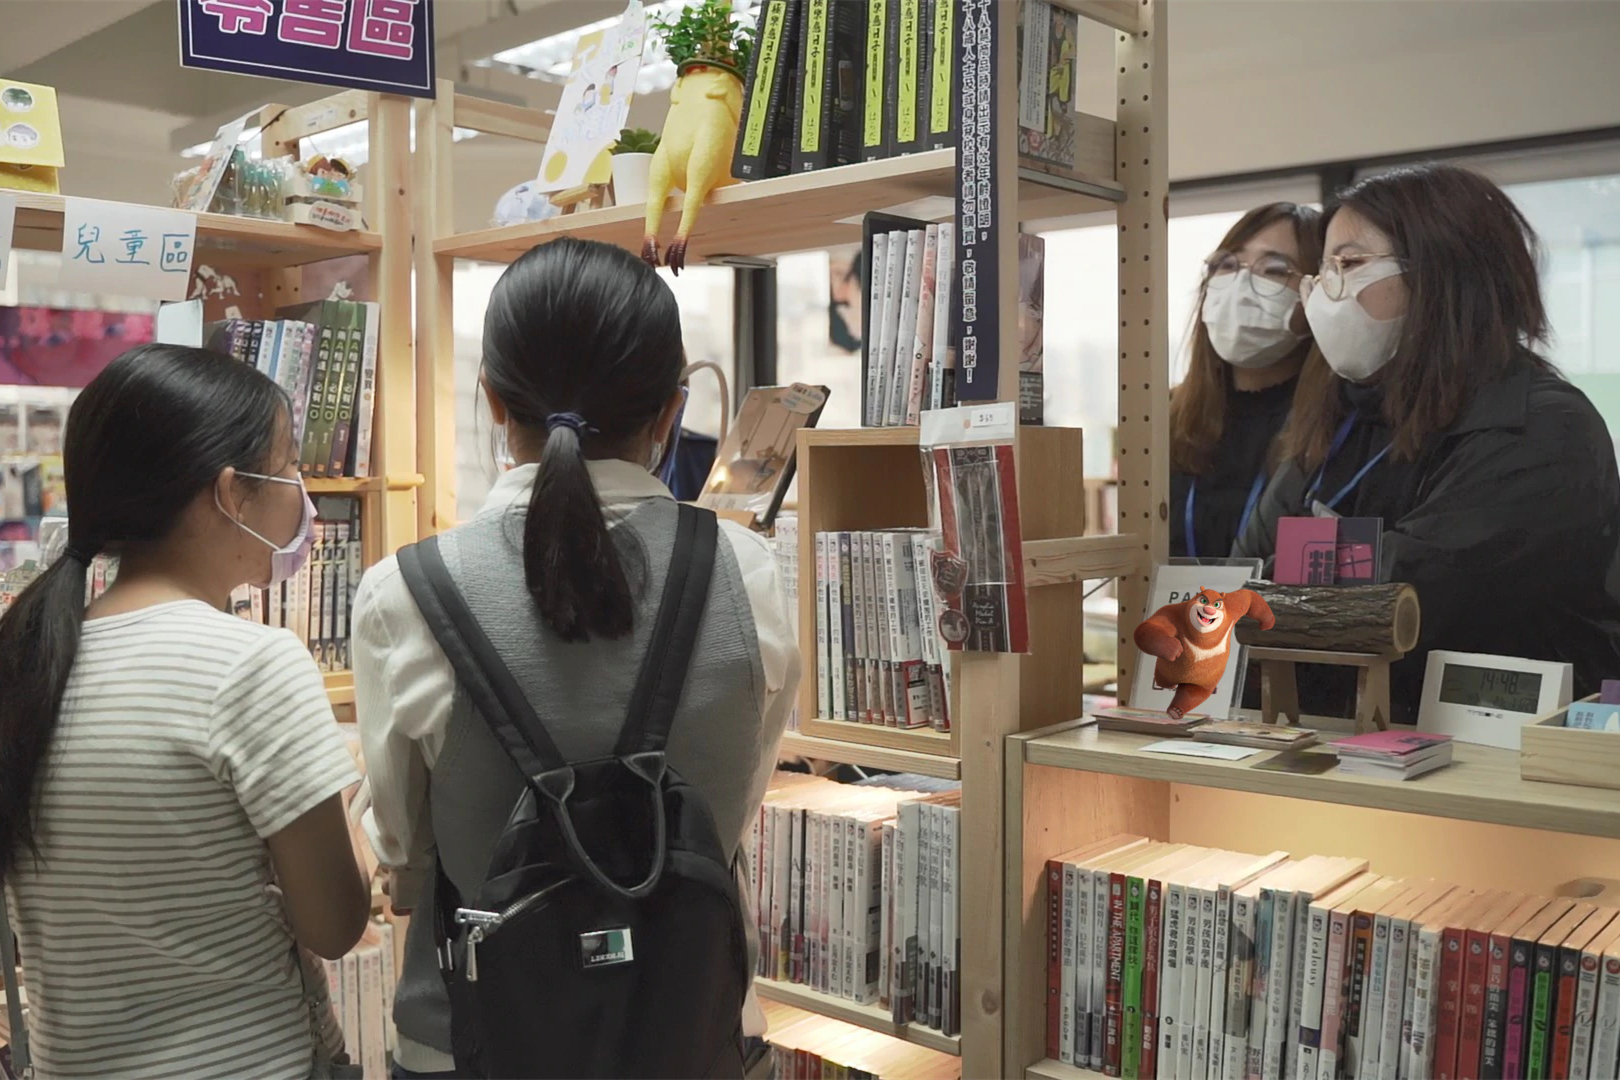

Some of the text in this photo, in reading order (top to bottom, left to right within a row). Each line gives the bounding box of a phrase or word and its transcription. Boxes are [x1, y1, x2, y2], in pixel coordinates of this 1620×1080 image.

[72, 222, 190, 273] 兒童區
[1480, 671, 1519, 695] 14:48
[1110, 900, 1122, 982] IN THE APARTMENT
[1306, 936, 1322, 988] Jealousy
